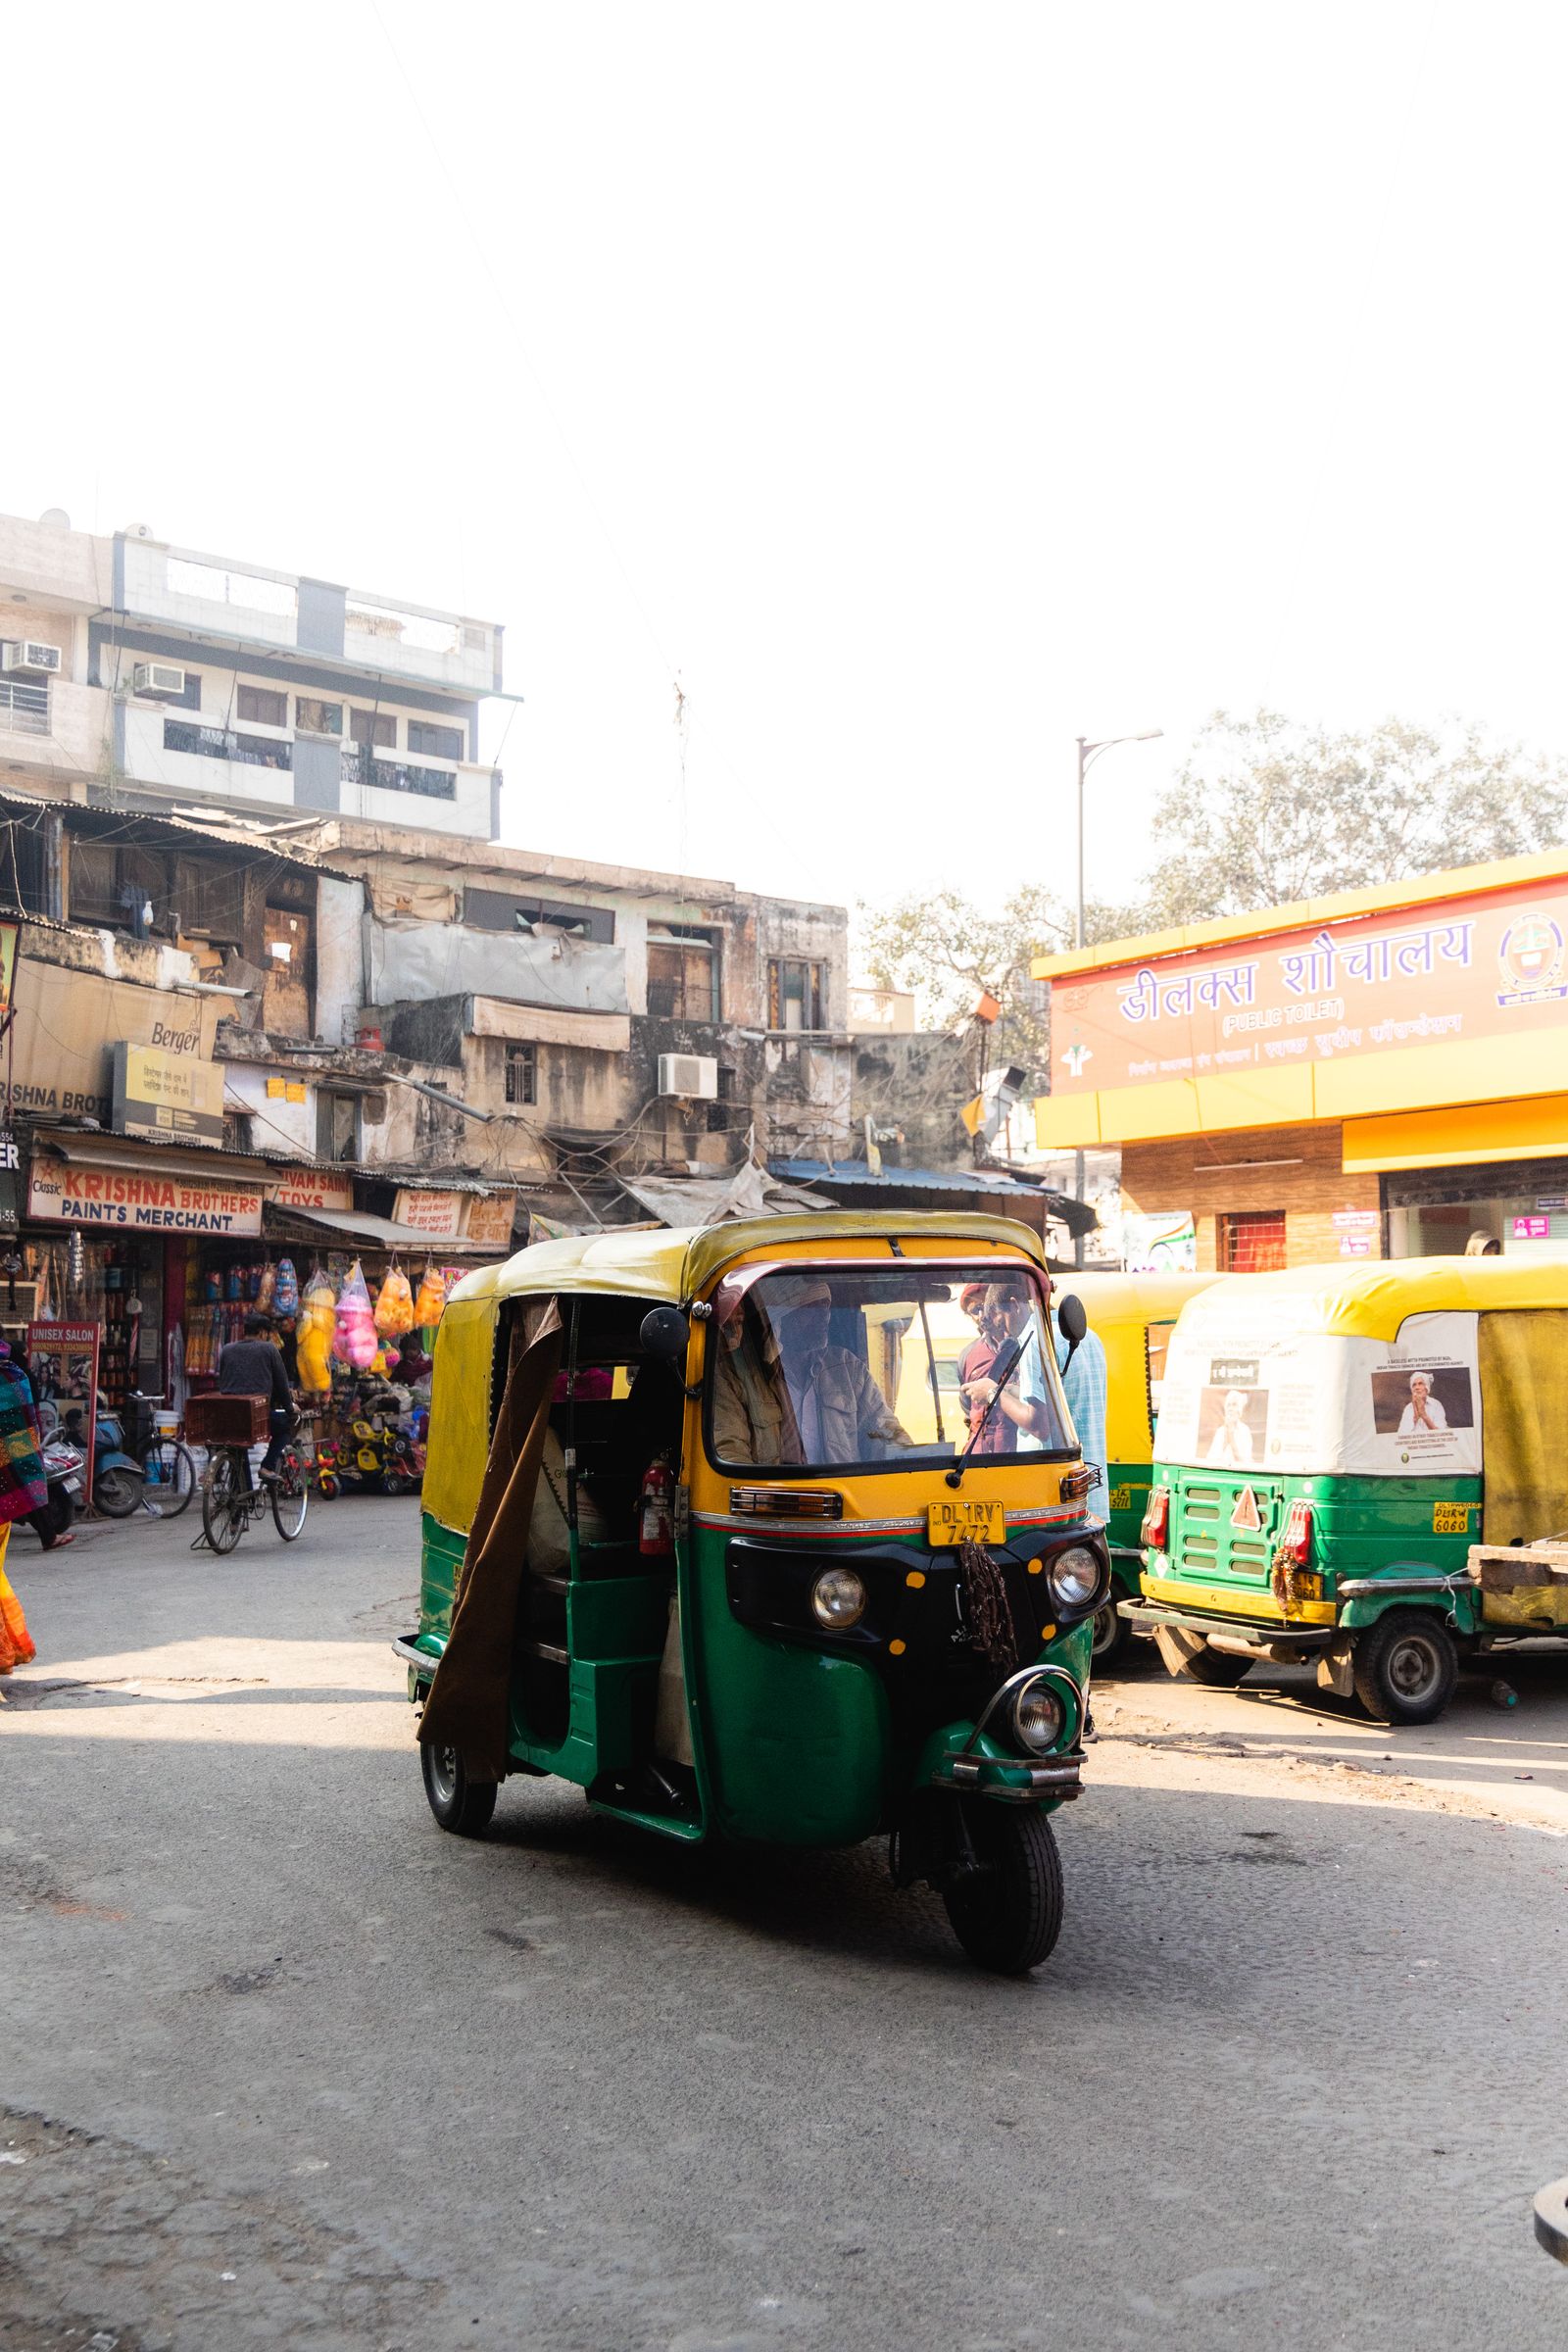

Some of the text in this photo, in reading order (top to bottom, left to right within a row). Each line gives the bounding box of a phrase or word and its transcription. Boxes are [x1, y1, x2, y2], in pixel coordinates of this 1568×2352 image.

[1118, 922, 1474, 1020] डीलक्स शौचालय
[1223, 998, 1345, 1037] (PUBLIC TOILET)
[152, 1022, 200, 1054] Berger
[32, 1179, 62, 1195] Classic
[65, 1170, 176, 1208] KRISHNA
[180, 1190, 259, 1213] BROTHERS
[279, 1191, 323, 1207] TOYS
[61, 1200, 232, 1231] PAINTS MERCHANT
[31, 1328, 94, 1342] UNISEX SALON
[1436, 1519, 1465, 1532] 6060
